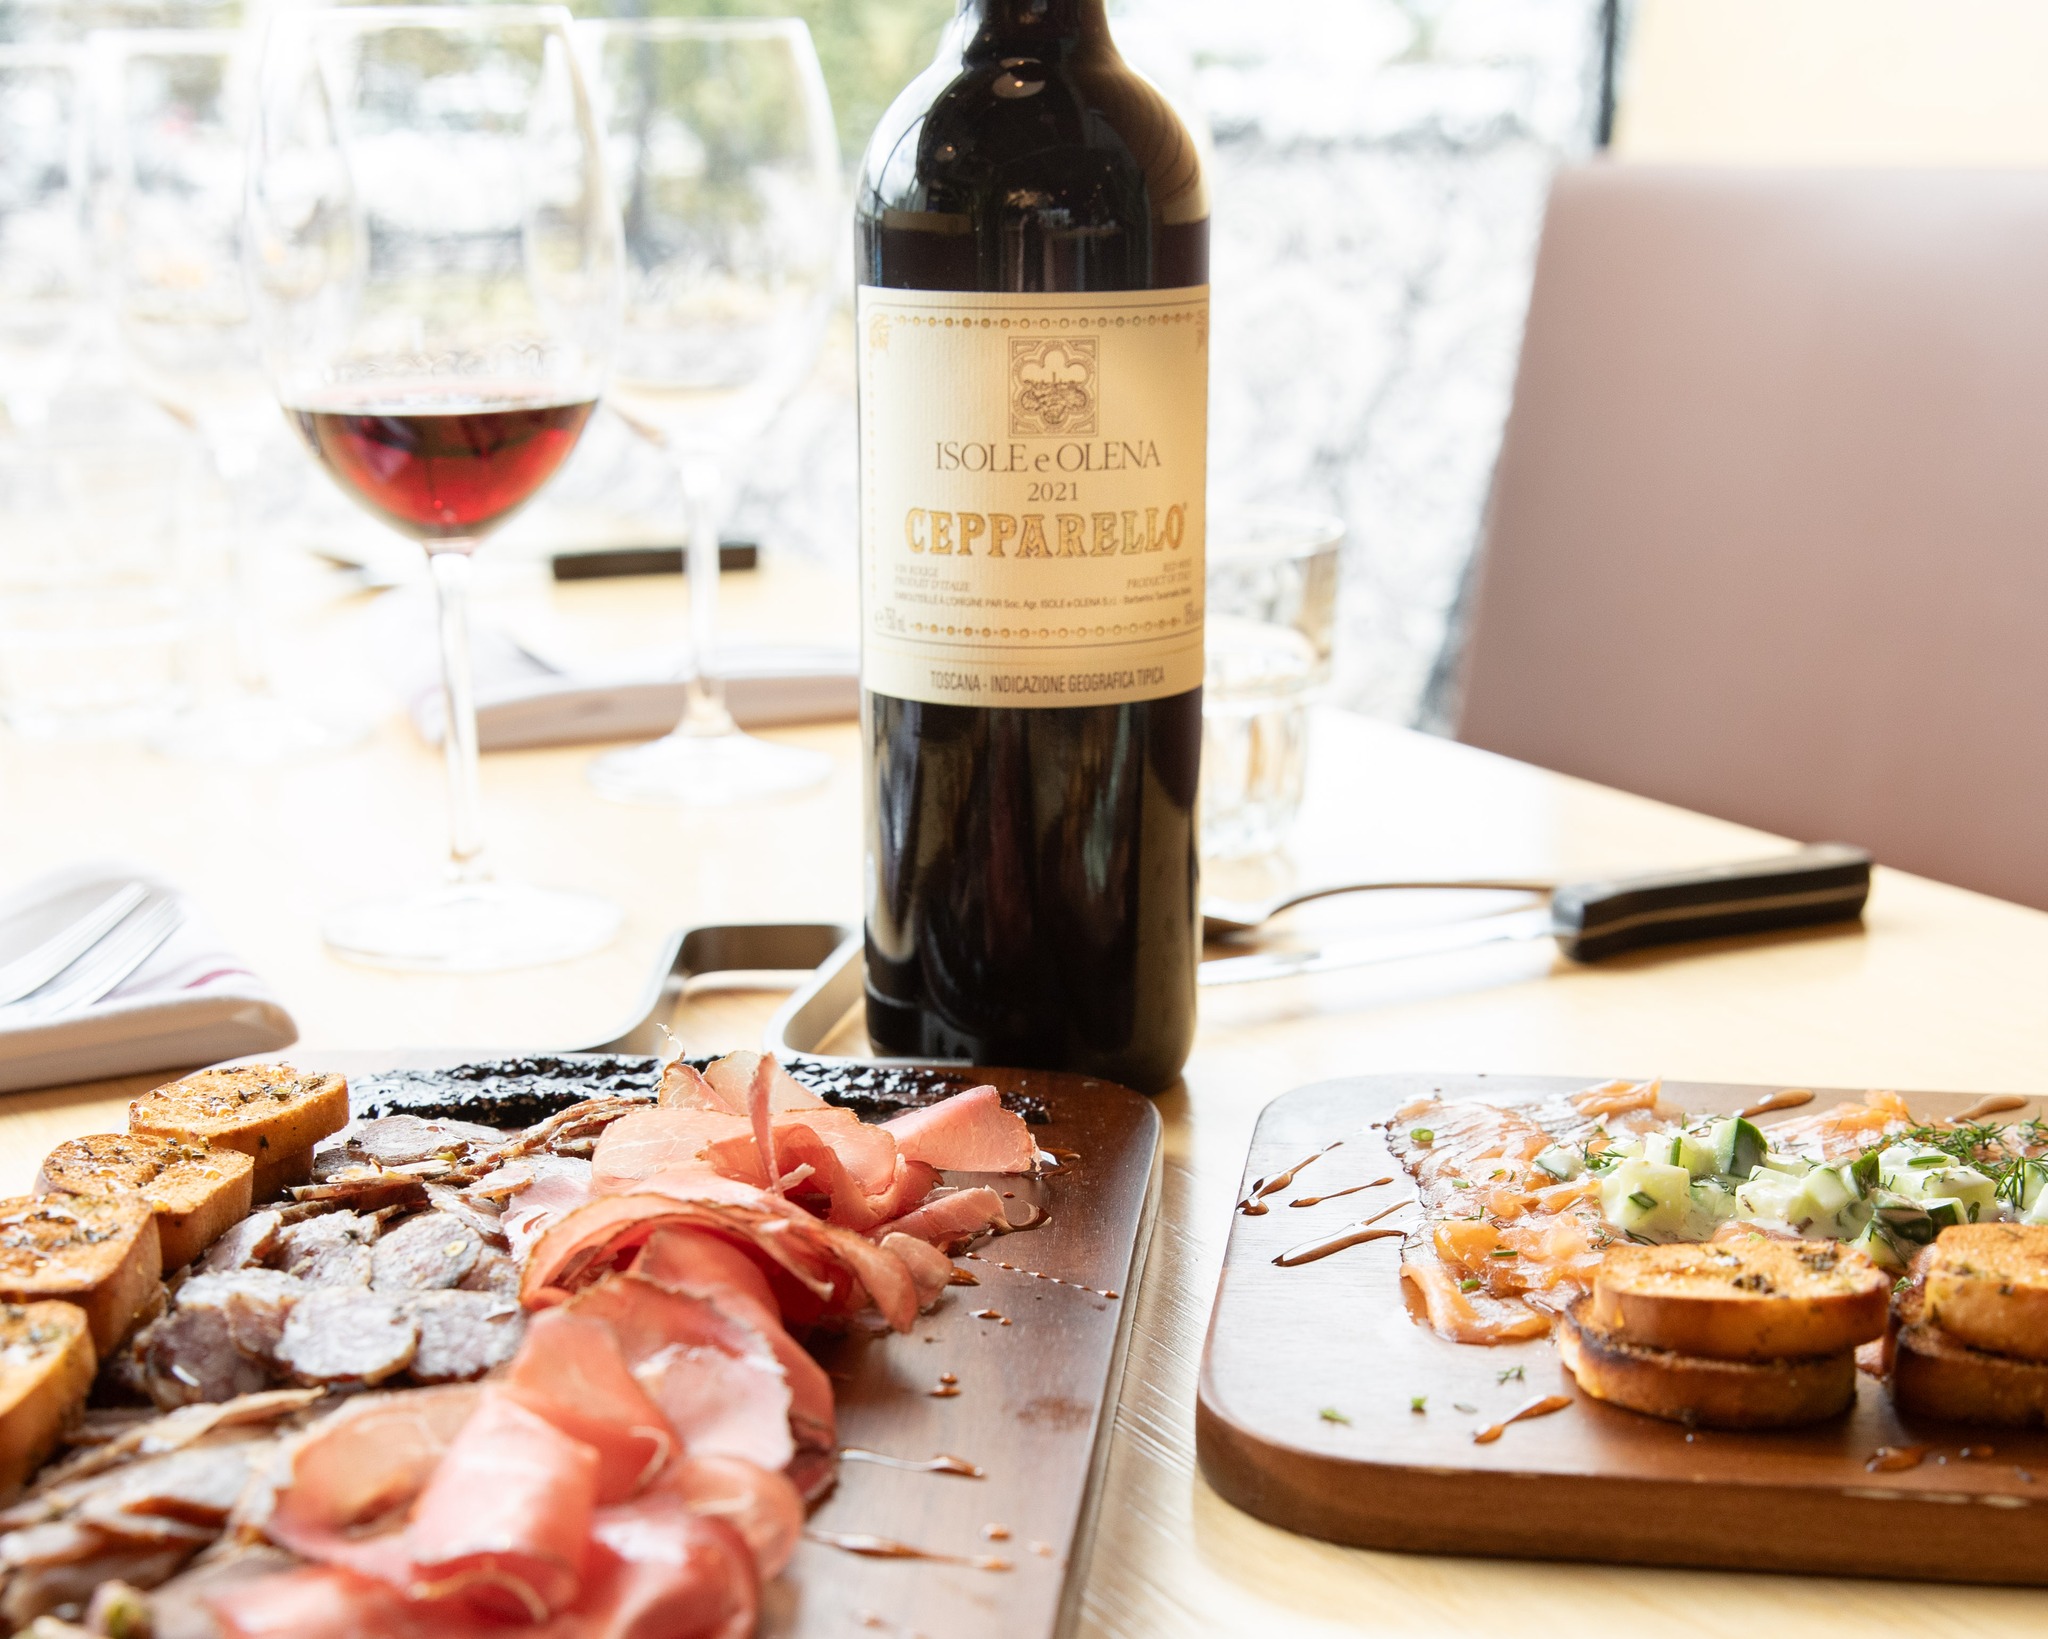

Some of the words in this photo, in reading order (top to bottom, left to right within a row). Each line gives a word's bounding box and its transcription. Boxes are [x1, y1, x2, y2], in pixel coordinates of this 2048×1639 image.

[936, 442, 1027, 472] ISOLE
[1034, 452, 1050, 473] e
[1057, 440, 1162, 471] OLENA
[1027, 481, 1079, 503] 2021
[905, 504, 1186, 558] CEPPARELLO
[931, 670, 981, 692] TOSCANA
[990, 674, 1066, 694] INDICAZIONE
[1068, 669, 1135, 693] GEOGRAFICA
[1137, 666, 1165, 688] TIPICA
